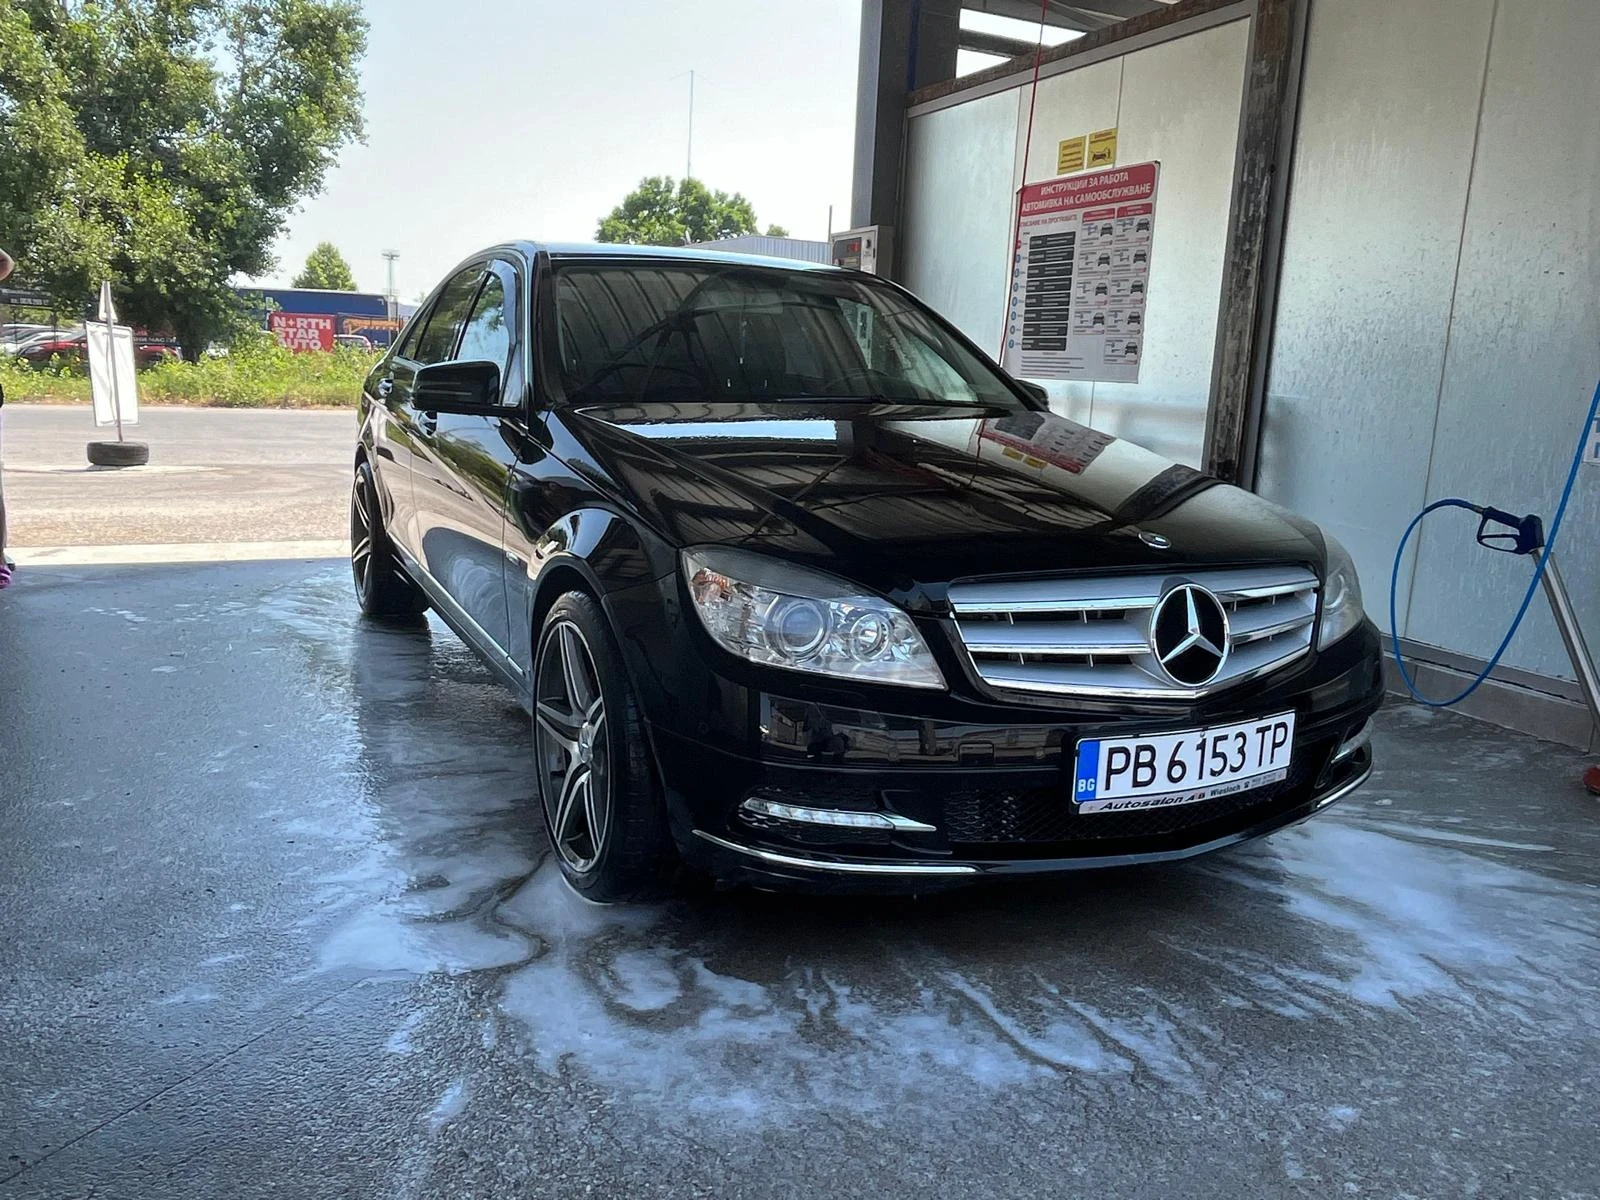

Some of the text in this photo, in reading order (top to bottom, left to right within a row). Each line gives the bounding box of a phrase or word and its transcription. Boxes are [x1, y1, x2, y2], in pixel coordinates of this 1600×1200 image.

[1041, 171, 1129, 196] ИНСТРУКЦИИ ЗА РАБОТА
[1063, 196, 1074, 206] НА
[1074, 182, 1151, 204] САМООБСЛУЖВАНЕ
[275, 327, 319, 339] STAR
[277, 338, 322, 350] AUTO
[1105, 721, 1289, 791] PB 6153 TP
[1077, 778, 1096, 793] BG
[1100, 796, 1183, 811] Autosalon
[1210, 784, 1241, 797] Wiesloch
